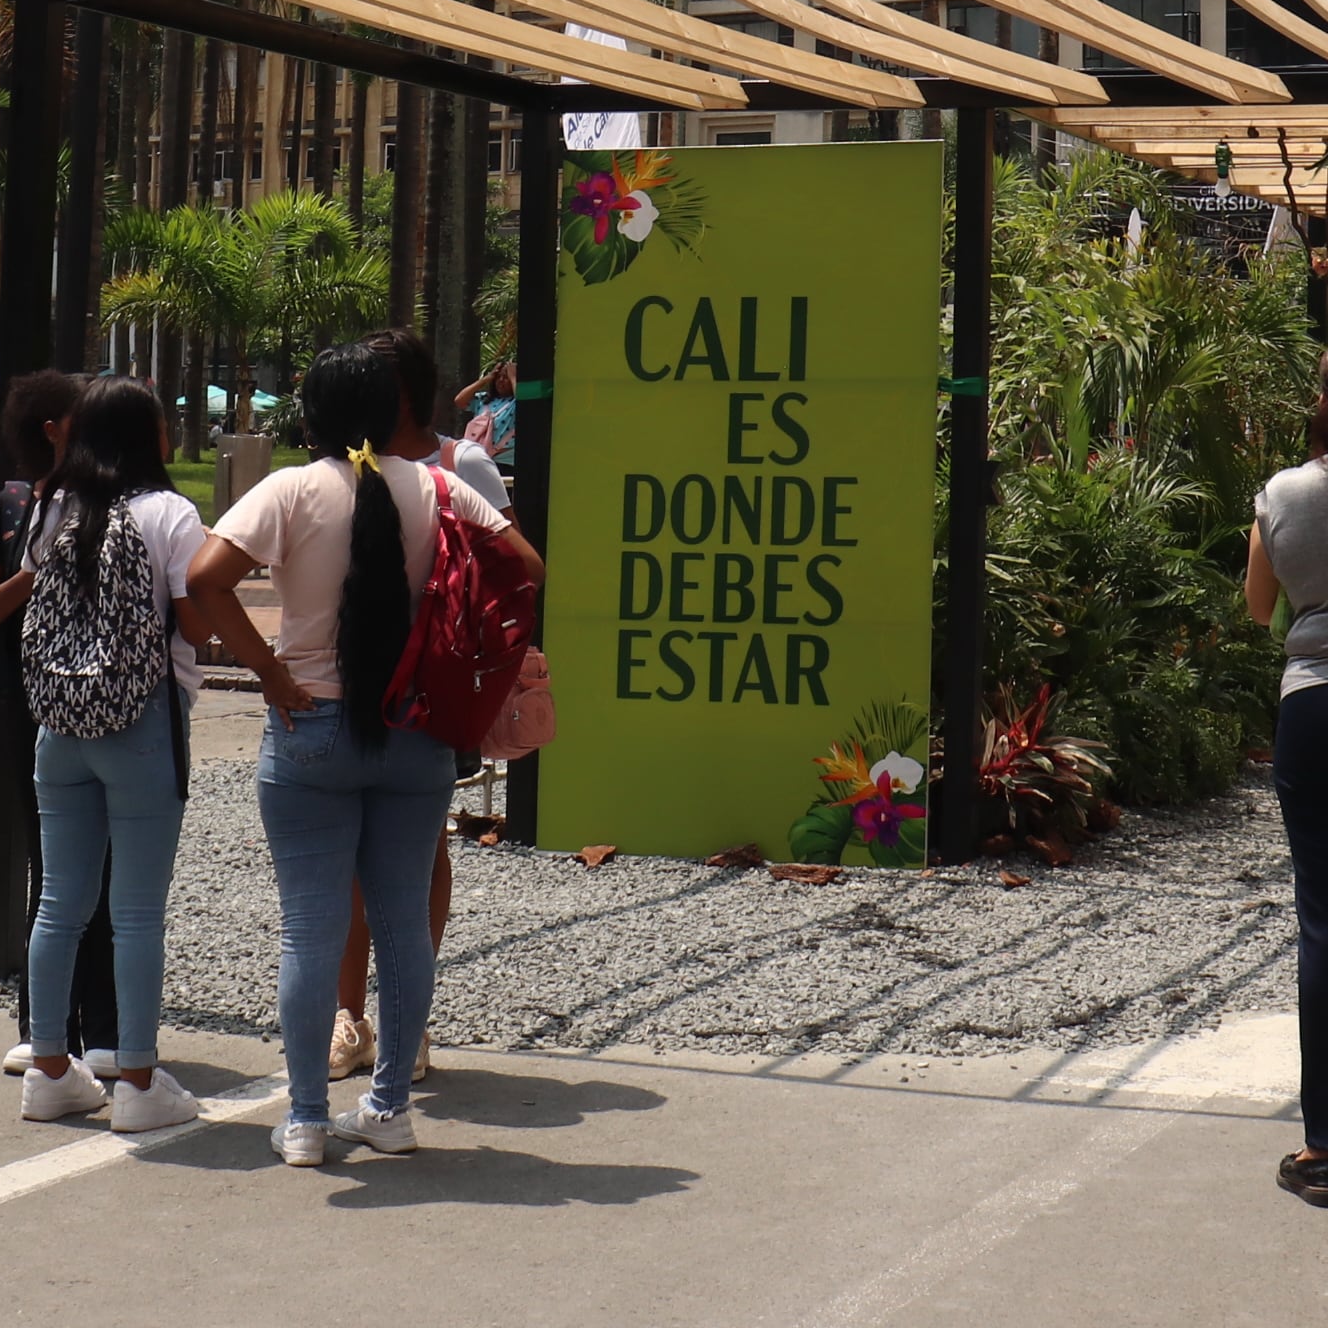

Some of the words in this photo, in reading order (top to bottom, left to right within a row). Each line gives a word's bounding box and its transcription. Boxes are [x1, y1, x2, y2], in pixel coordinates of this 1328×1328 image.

[624, 295, 809, 382] CALI
[728, 392, 810, 465] ES
[623, 474, 858, 547] DONDE
[620, 552, 844, 627] DEBES
[616, 629, 831, 706] ESTAR
